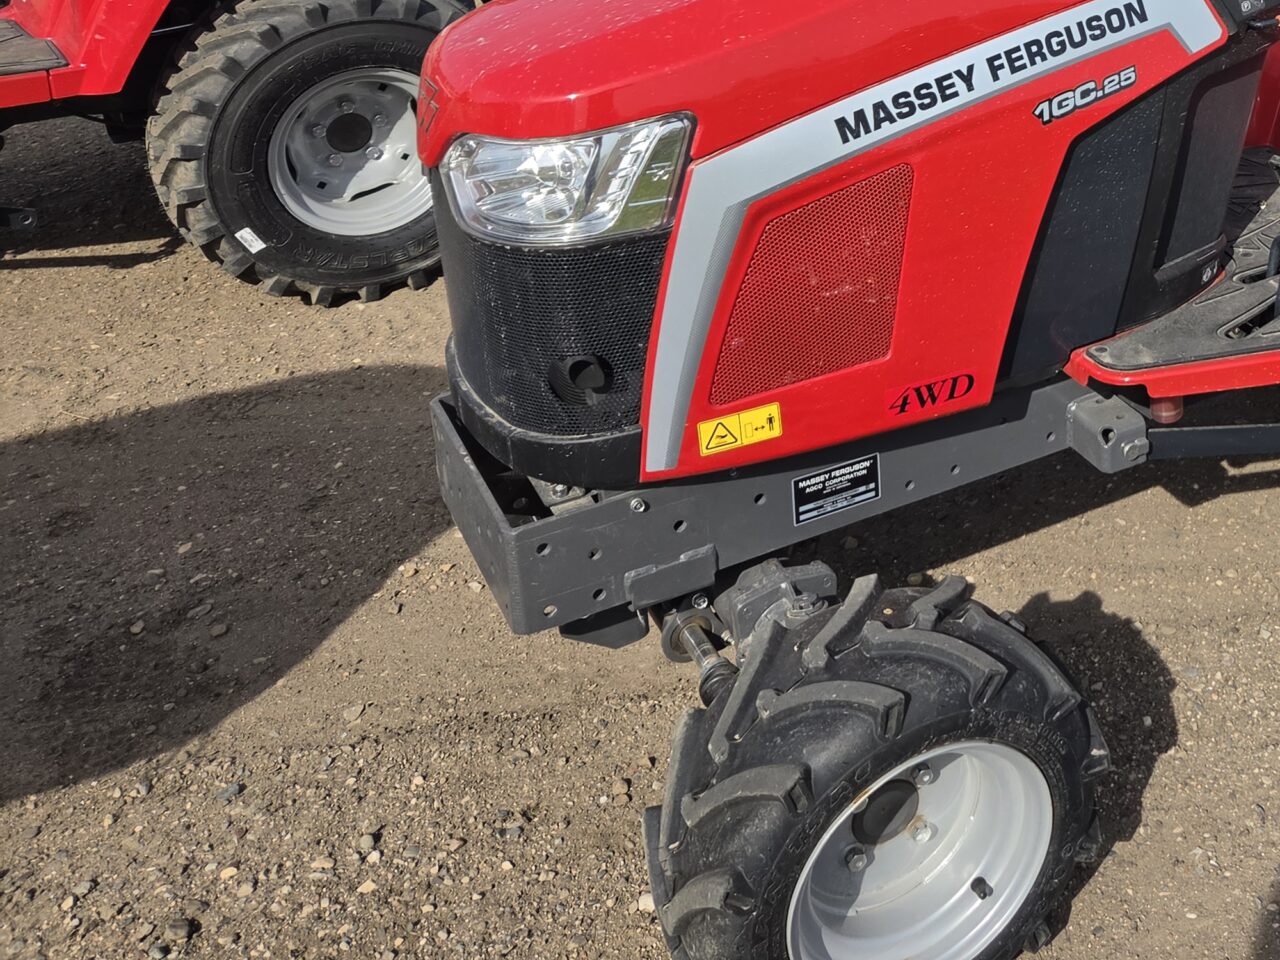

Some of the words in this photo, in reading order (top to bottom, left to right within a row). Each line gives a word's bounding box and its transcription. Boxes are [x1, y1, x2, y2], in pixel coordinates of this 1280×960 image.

[834, 64, 975, 144] MASSEY
[1033, 67, 1136, 125] 1GC.25
[888, 373, 975, 416] 4WD
[798, 473, 830, 488] MASSEY
[831, 459, 870, 478] FERGUSON
[805, 483, 823, 494] AGCO
[825, 469, 867, 486] CORPORATION
